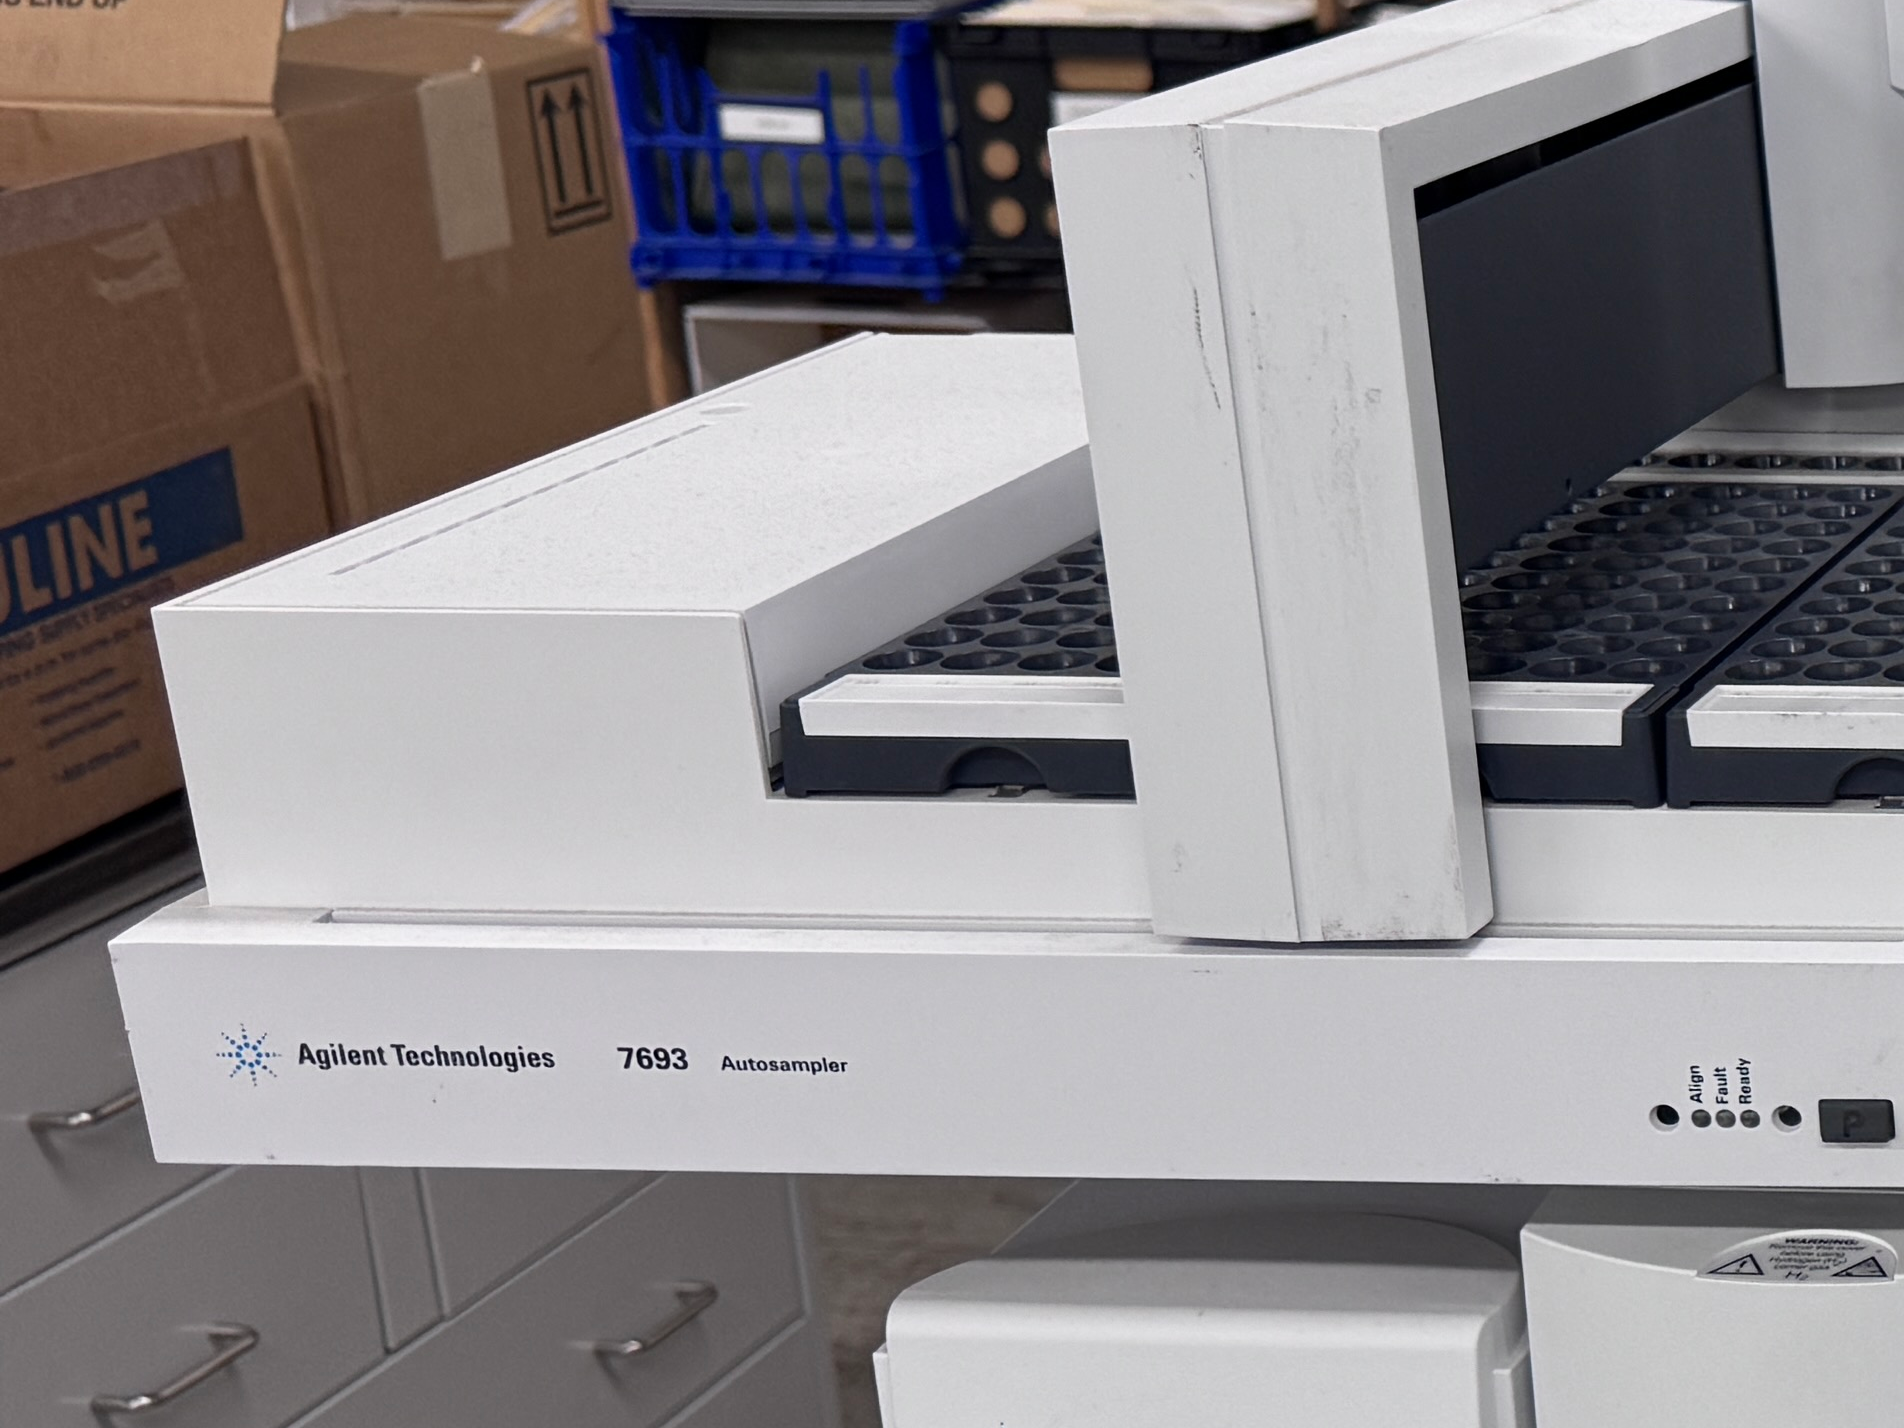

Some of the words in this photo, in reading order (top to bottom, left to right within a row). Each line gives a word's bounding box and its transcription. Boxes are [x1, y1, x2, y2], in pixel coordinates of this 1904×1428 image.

[298, 1042, 388, 1071] Agilent
[389, 1043, 556, 1073] Technologies
[616, 1046, 689, 1071] 7693
[721, 1055, 848, 1076] Autosampler
[1688, 1065, 1704, 1104] Align
[1713, 1067, 1729, 1105] Fault
[1735, 1057, 1752, 1105] Ready
